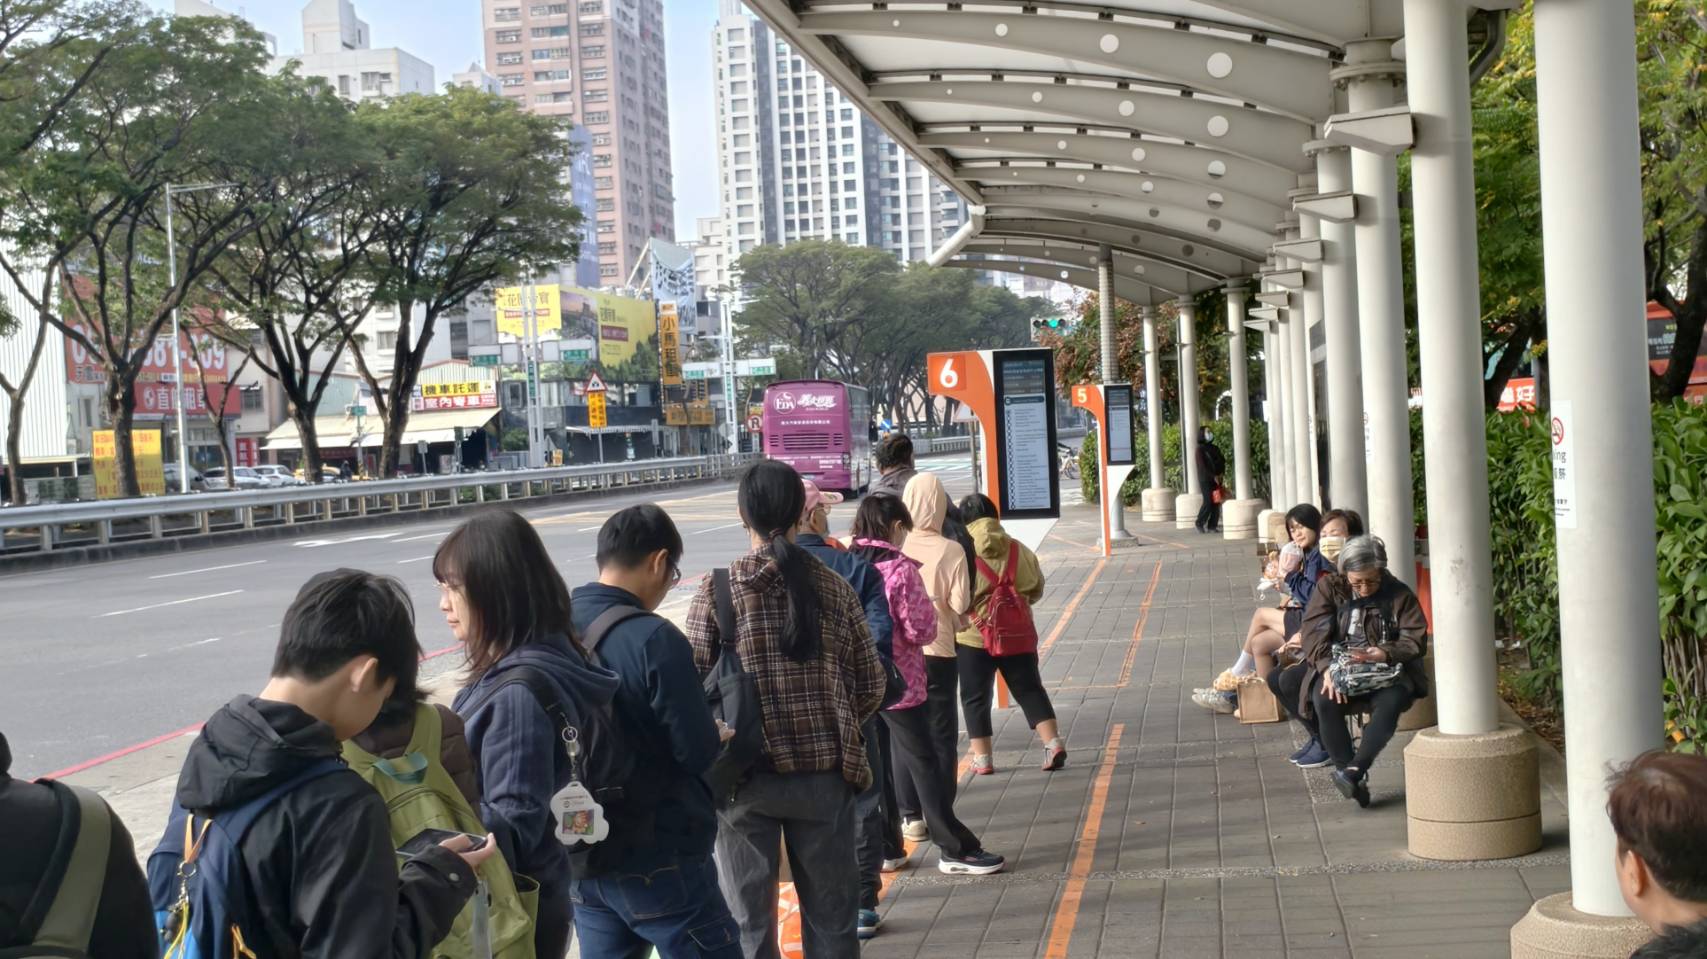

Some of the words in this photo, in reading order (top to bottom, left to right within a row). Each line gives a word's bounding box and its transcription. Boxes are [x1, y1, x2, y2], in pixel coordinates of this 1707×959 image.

[939, 358, 958, 388] 6
[1077, 388, 1088, 403] 5
[776, 398, 795, 410] EDA
[1551, 449, 1567, 464] ing
